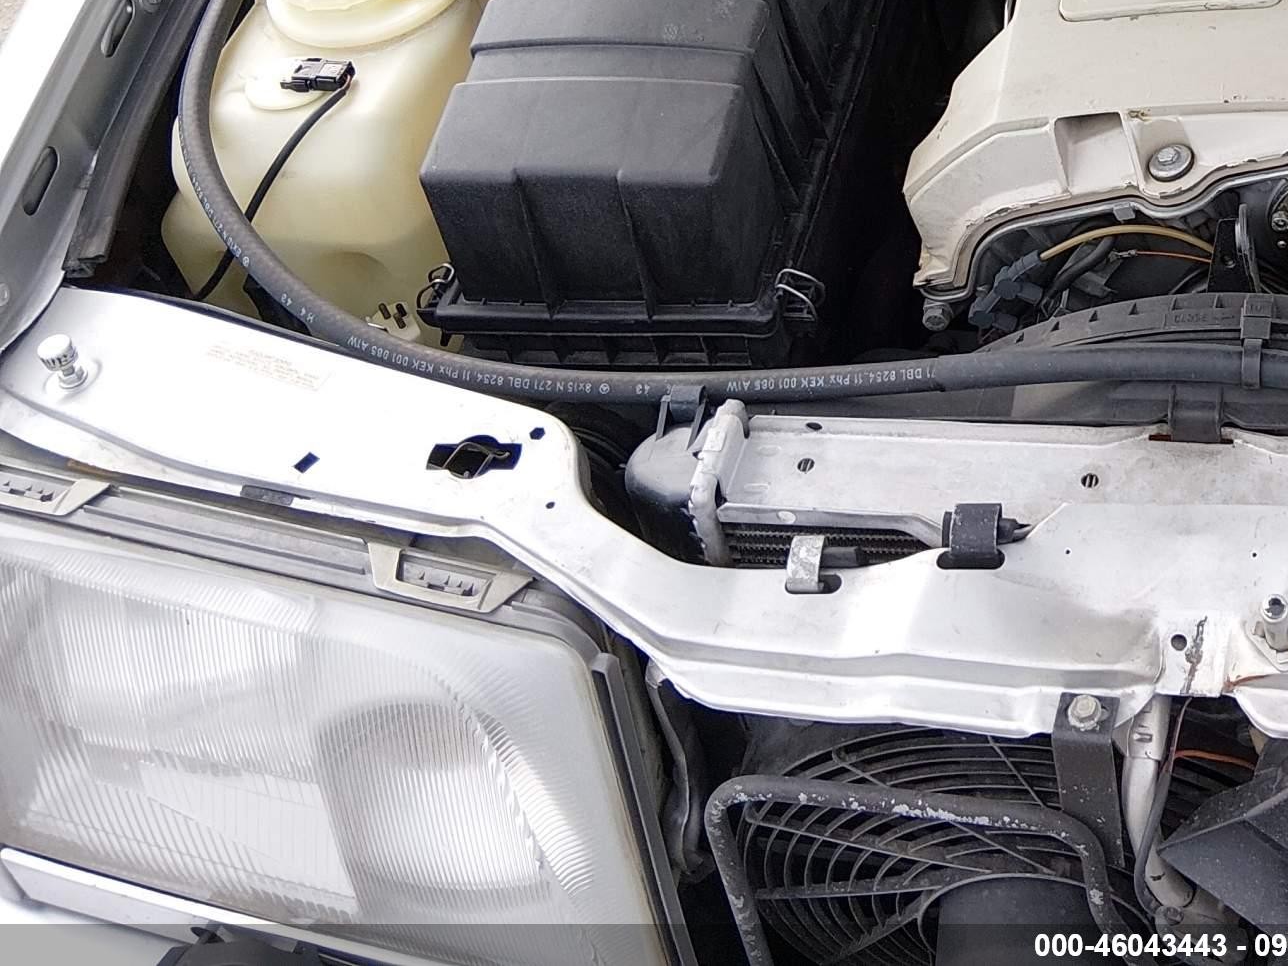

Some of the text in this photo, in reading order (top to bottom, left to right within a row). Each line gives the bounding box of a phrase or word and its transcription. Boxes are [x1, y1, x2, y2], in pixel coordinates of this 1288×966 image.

[391, 353, 409, 367] 001
[411, 358, 435, 373] KEK
[901, 367, 923, 380] DBL
[508, 376, 530, 388] DBL
[533, 379, 552, 392] 271
[555, 381, 564, 392] N
[567, 382, 592, 394] 8x15
[800, 375, 825, 388] KEK
